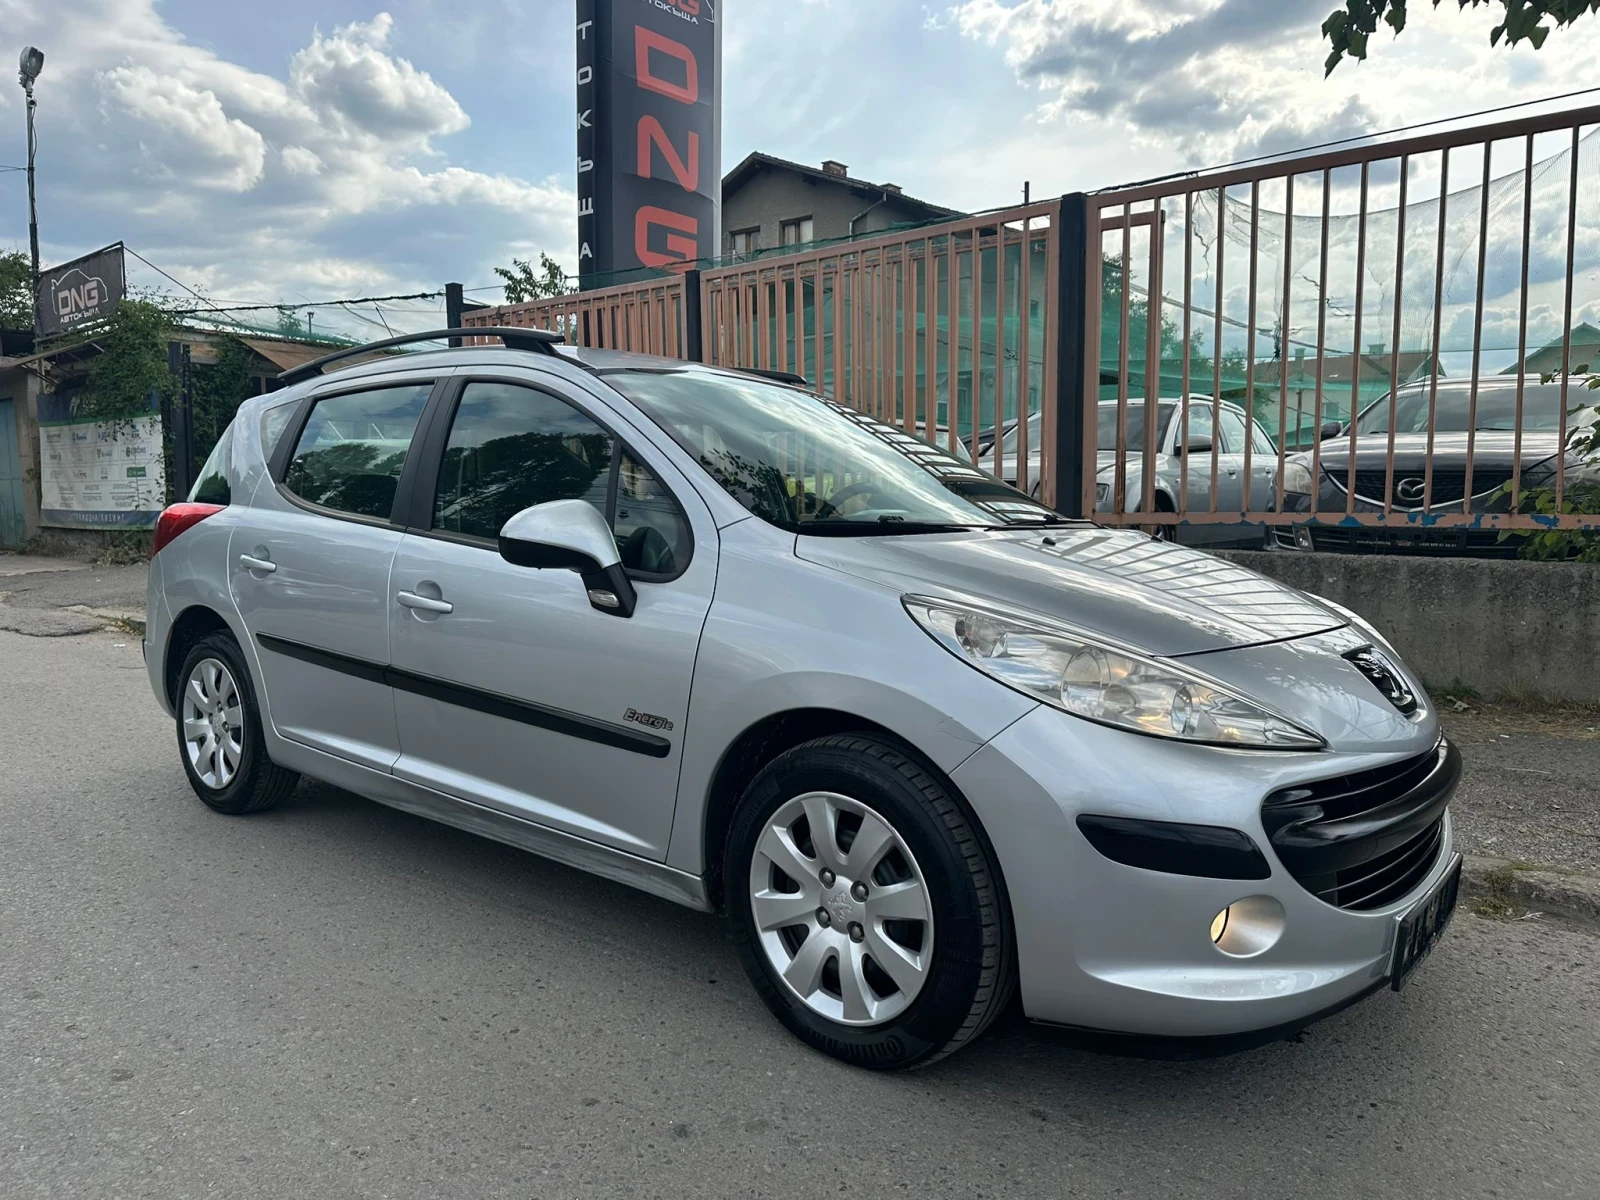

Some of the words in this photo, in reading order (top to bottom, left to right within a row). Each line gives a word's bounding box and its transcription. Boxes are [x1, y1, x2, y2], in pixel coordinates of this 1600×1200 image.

[634, 24, 699, 275] DNG
[57, 280, 99, 316] DNG
[623, 707, 674, 731] Energie
